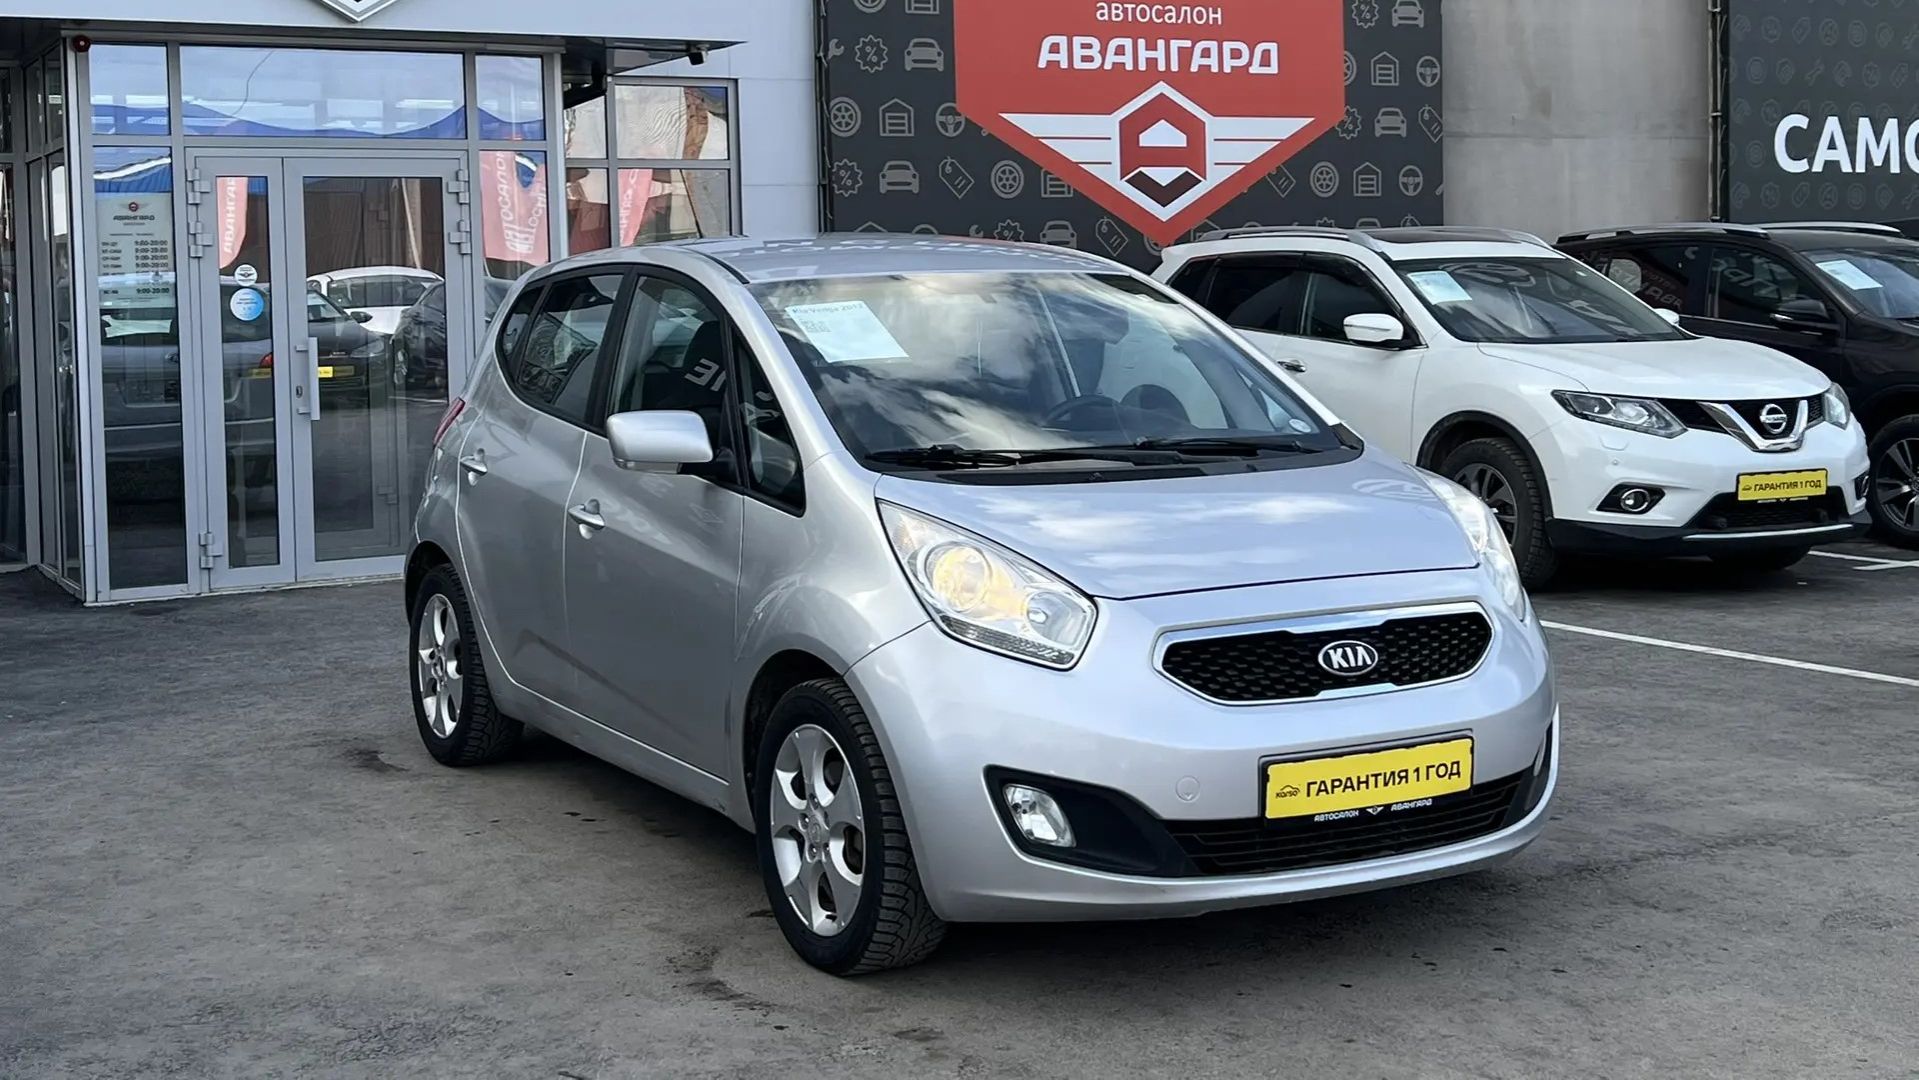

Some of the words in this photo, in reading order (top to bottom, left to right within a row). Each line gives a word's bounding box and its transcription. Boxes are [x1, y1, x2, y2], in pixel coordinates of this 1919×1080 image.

[1096, 2, 1222, 25] автосалон
[1037, 35, 1279, 74] АВАНГАРД
[1753, 482, 1798, 492] ГАРАНТИЯ
[1804, 480, 1822, 488] ГОД
[1327, 646, 1372, 669] KIA
[1306, 769, 1409, 797] ГАРАНТИЯ
[1413, 767, 1420, 782] 1
[1425, 760, 1461, 780] ГОД
[1314, 810, 1359, 822] АВТОСАЛОН
[1391, 798, 1432, 811] АВАНГАРД
